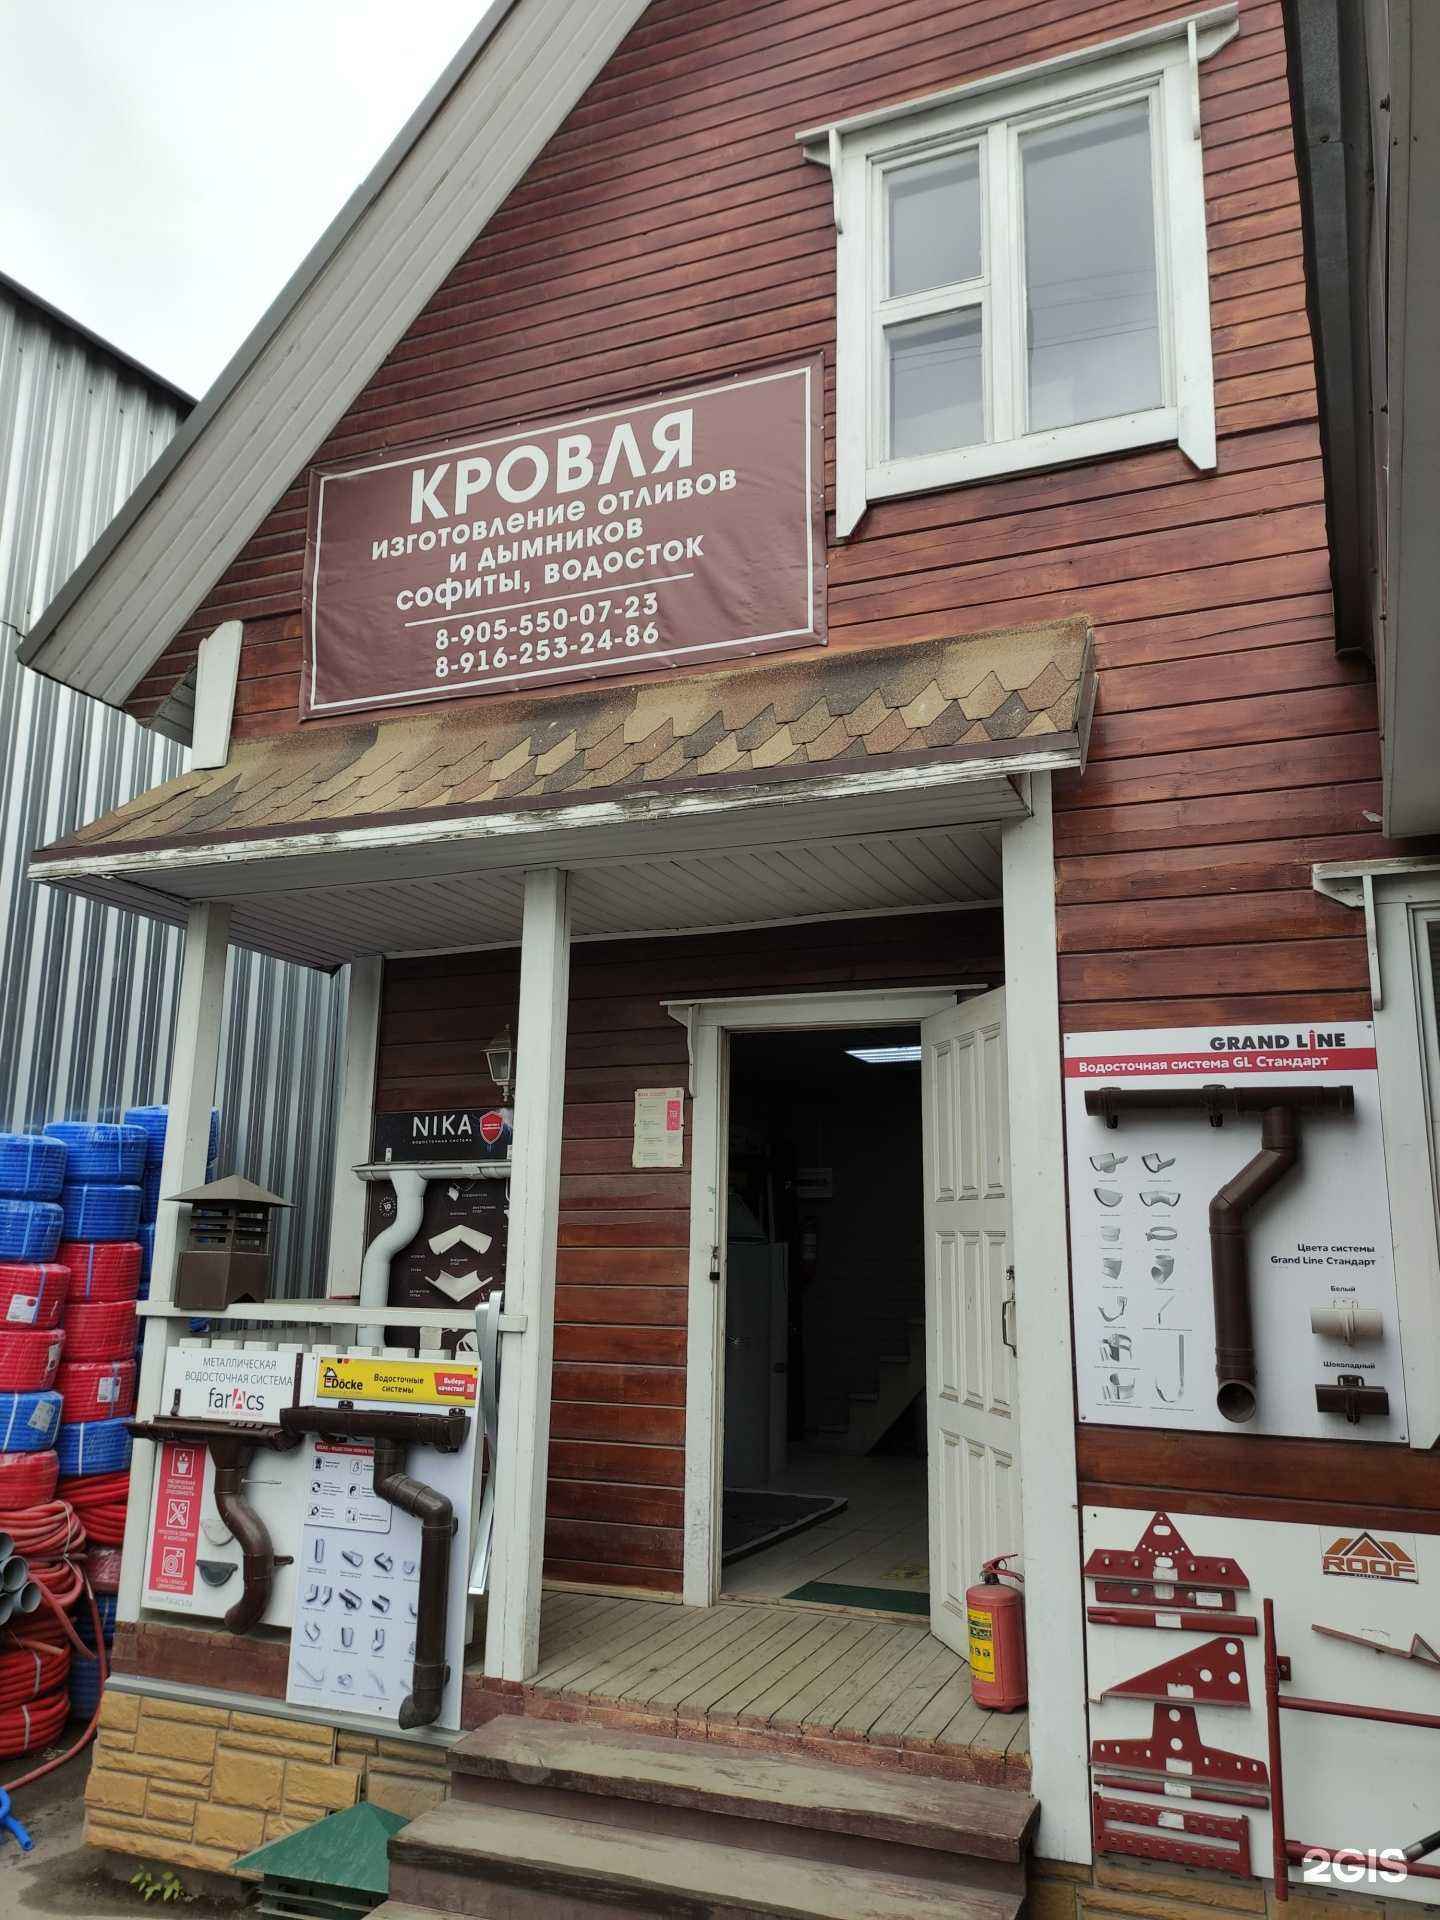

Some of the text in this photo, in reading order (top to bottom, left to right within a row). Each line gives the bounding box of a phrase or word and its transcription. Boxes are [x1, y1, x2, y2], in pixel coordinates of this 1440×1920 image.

[409, 408, 695, 525] КРОВЛЯ
[371, 468, 738, 561] изготовление отливов
[449, 516, 645, 574] и дымников
[396, 534, 705, 612] софиты, водосток
[435, 591, 659, 651] 8-905-550-07-23
[435, 621, 660, 679] 8-916-253-24-86
[1209, 1034, 1290, 1051] GRAND
[1079, 1055, 1329, 1073] Водосточная система GL Стандарт
[412, 1114, 473, 1137] NIKA
[1297, 1243, 1375, 1253] Цвета системы
[1270, 1255, 1377, 1267] Grand Line Стандарт
[1330, 1285, 1356, 1293] Белый
[203, 1356, 277, 1370] МЕТАЛЛИЧЕСКАЯ
[1323, 1360, 1376, 1370] Шоколадный
[185, 1370, 294, 1387] ВОДОСТОЧНАЯ СИСТЕМА
[373, 1373, 425, 1385] Водосточные
[381, 1385, 414, 1394] системы
[1322, 1555, 1416, 1577] ROOF
